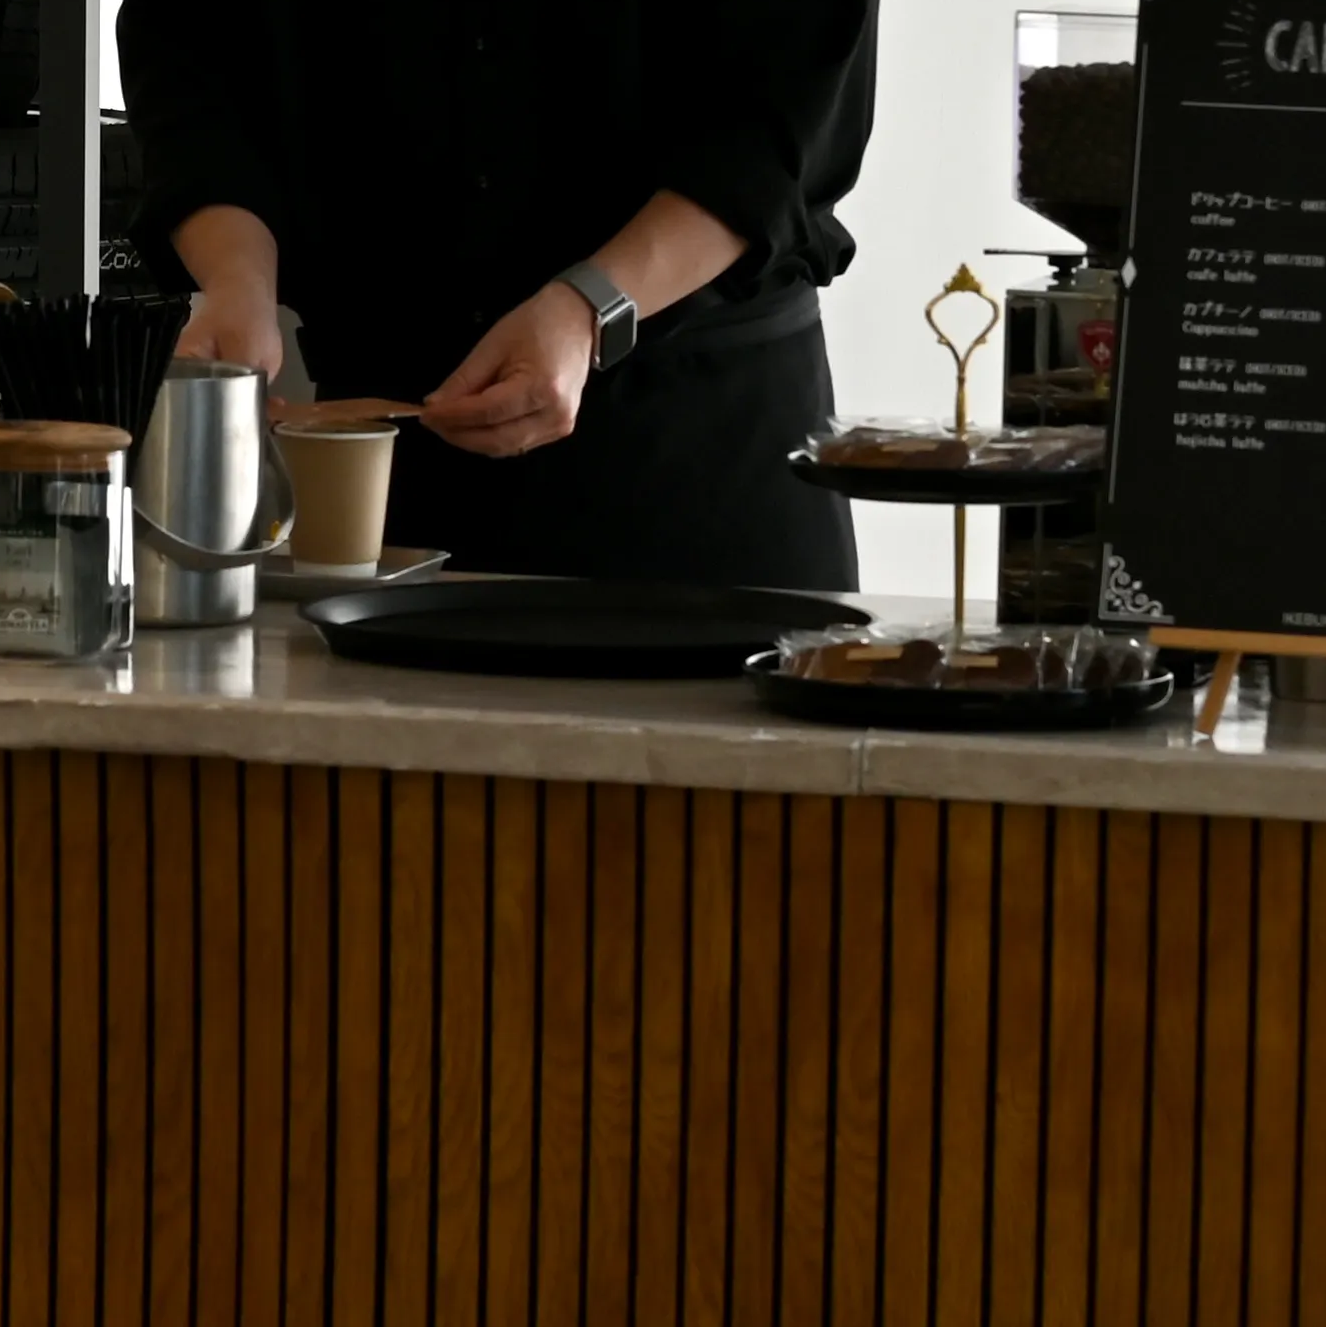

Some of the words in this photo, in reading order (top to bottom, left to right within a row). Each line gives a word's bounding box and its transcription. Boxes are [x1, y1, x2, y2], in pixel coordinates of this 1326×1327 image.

[1190, 191, 1292, 211] ドリップコーヒー
[1190, 213, 1236, 227] coffee
[1187, 247, 1254, 264] カフェラテ
[1223, 269, 1257, 283] latte
[1183, 300, 1252, 318] カプチーノ
[1177, 378, 1228, 393] matcha
[1233, 380, 1267, 394] latte
[1175, 433, 1227, 449] hojicha
[1231, 436, 1265, 450] latte
